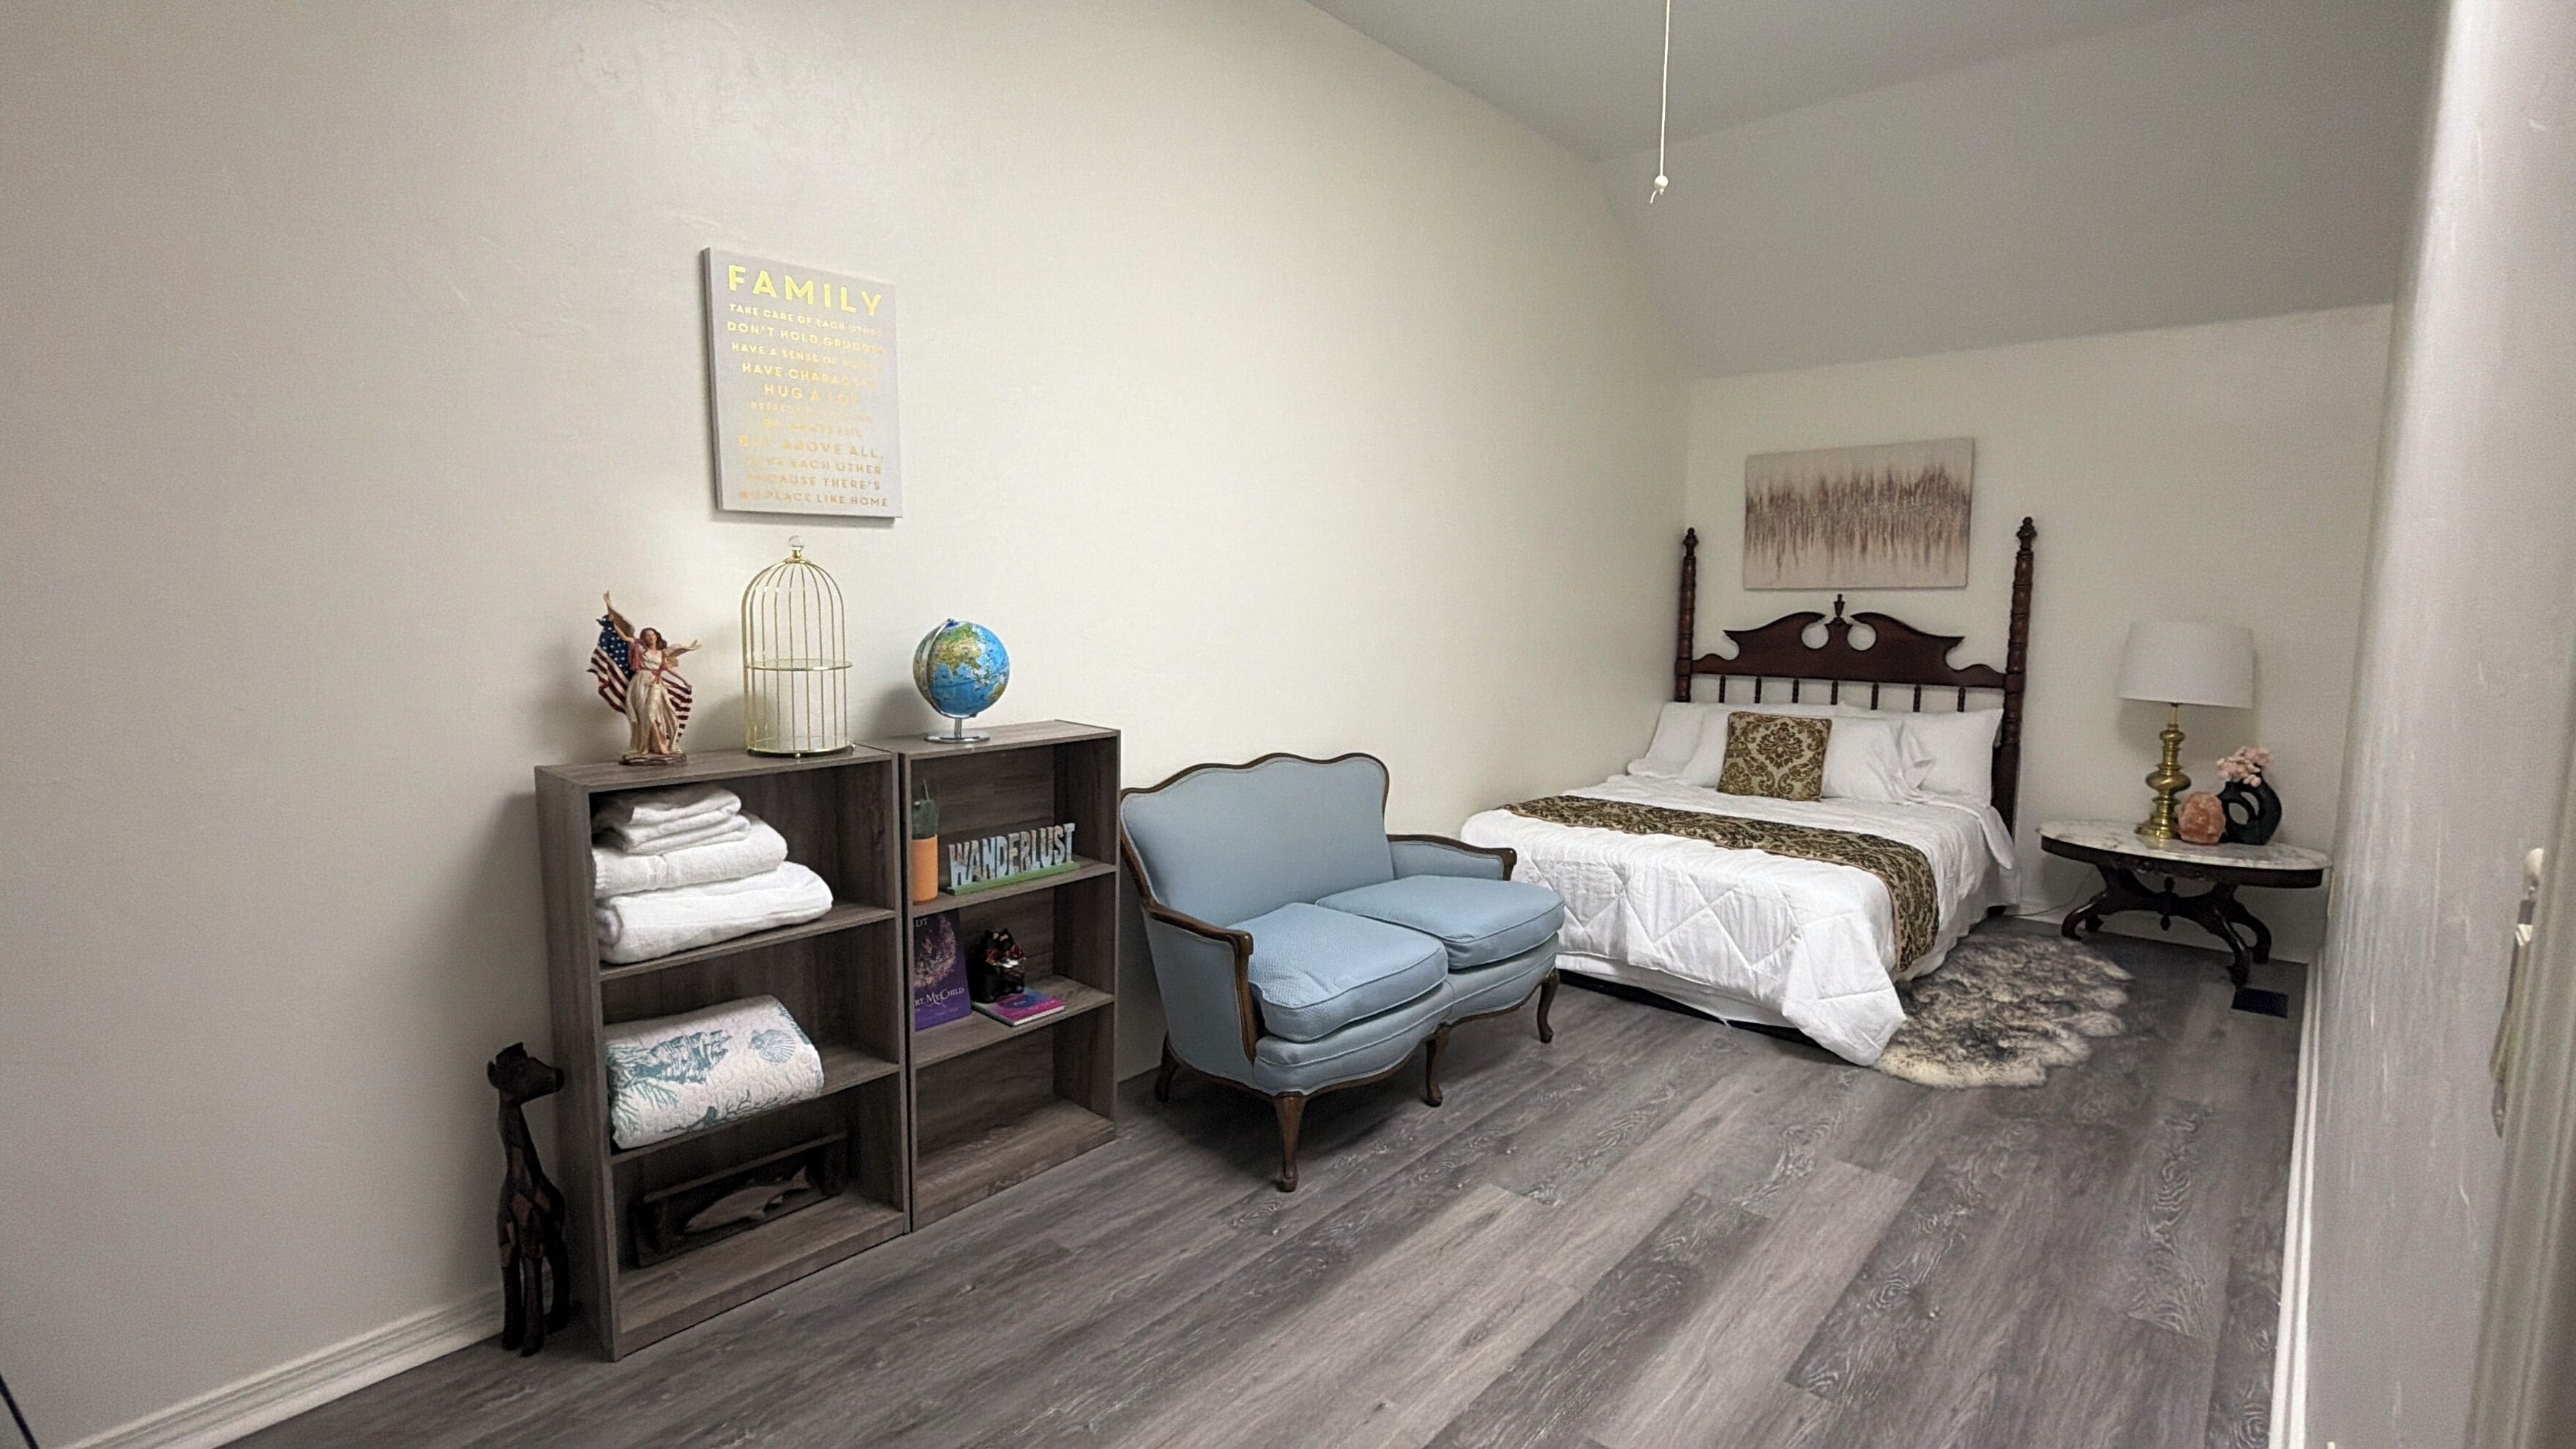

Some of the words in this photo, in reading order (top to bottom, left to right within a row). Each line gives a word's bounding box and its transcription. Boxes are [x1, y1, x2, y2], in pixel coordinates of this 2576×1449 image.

[728, 264, 882, 316] FAMILY
[729, 304, 758, 316] TAKE
[763, 309, 794, 322] CARE
[797, 315, 812, 324] OF
[816, 319, 845, 330] EACH
[727, 321, 774, 337] DON'T
[780, 330, 818, 343] HOLD
[732, 342, 766, 355] HAVE
[769, 348, 777, 356] A
[781, 349, 818, 362] SENSE
[742, 363, 783, 377] HAVE
[789, 369, 878, 391] CHARAC
[764, 383, 804, 399] HUG
[809, 389, 820, 401] A
[791, 458, 830, 470] EACH
[836, 463, 881, 474] OTHER
[747, 472, 816, 486] CAUSE
[823, 477, 880, 490] THERE'S
[765, 491, 811, 502] PLACE
[817, 494, 846, 504] LIKE
[850, 497, 888, 507] HOME
[948, 823, 1076, 888] WANDERLUST
